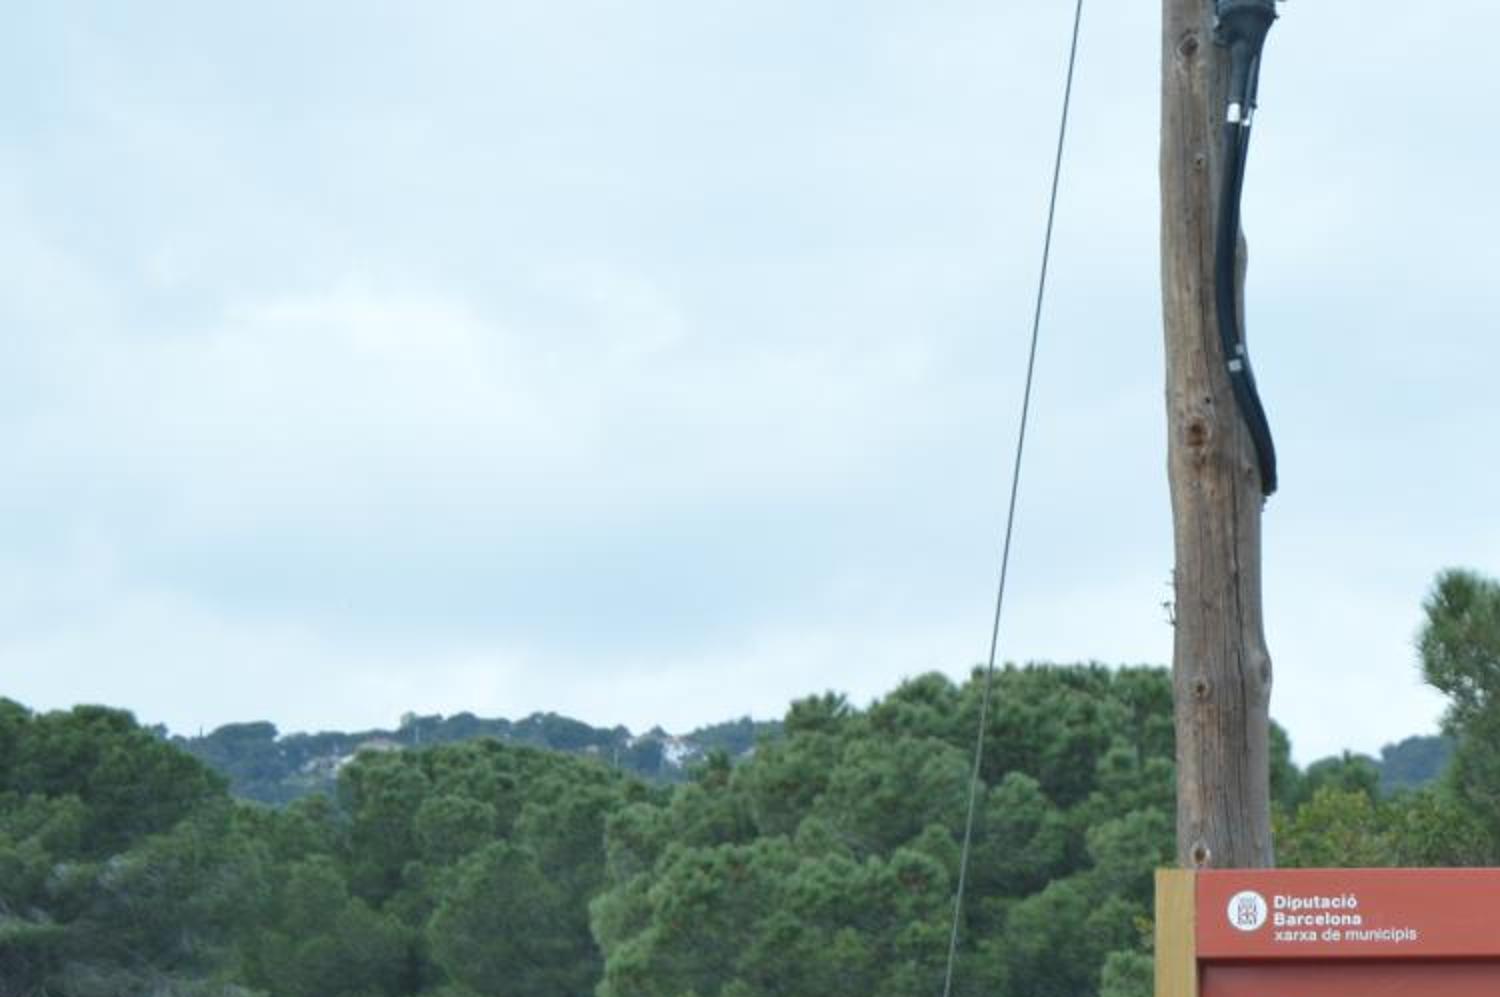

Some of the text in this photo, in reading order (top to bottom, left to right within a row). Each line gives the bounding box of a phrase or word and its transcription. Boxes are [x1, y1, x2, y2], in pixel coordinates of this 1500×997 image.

[1274, 894, 1357, 909] Diputació
[1274, 912, 1361, 925] Barcelona
[1274, 927, 1417, 943] xarxa de municipis
